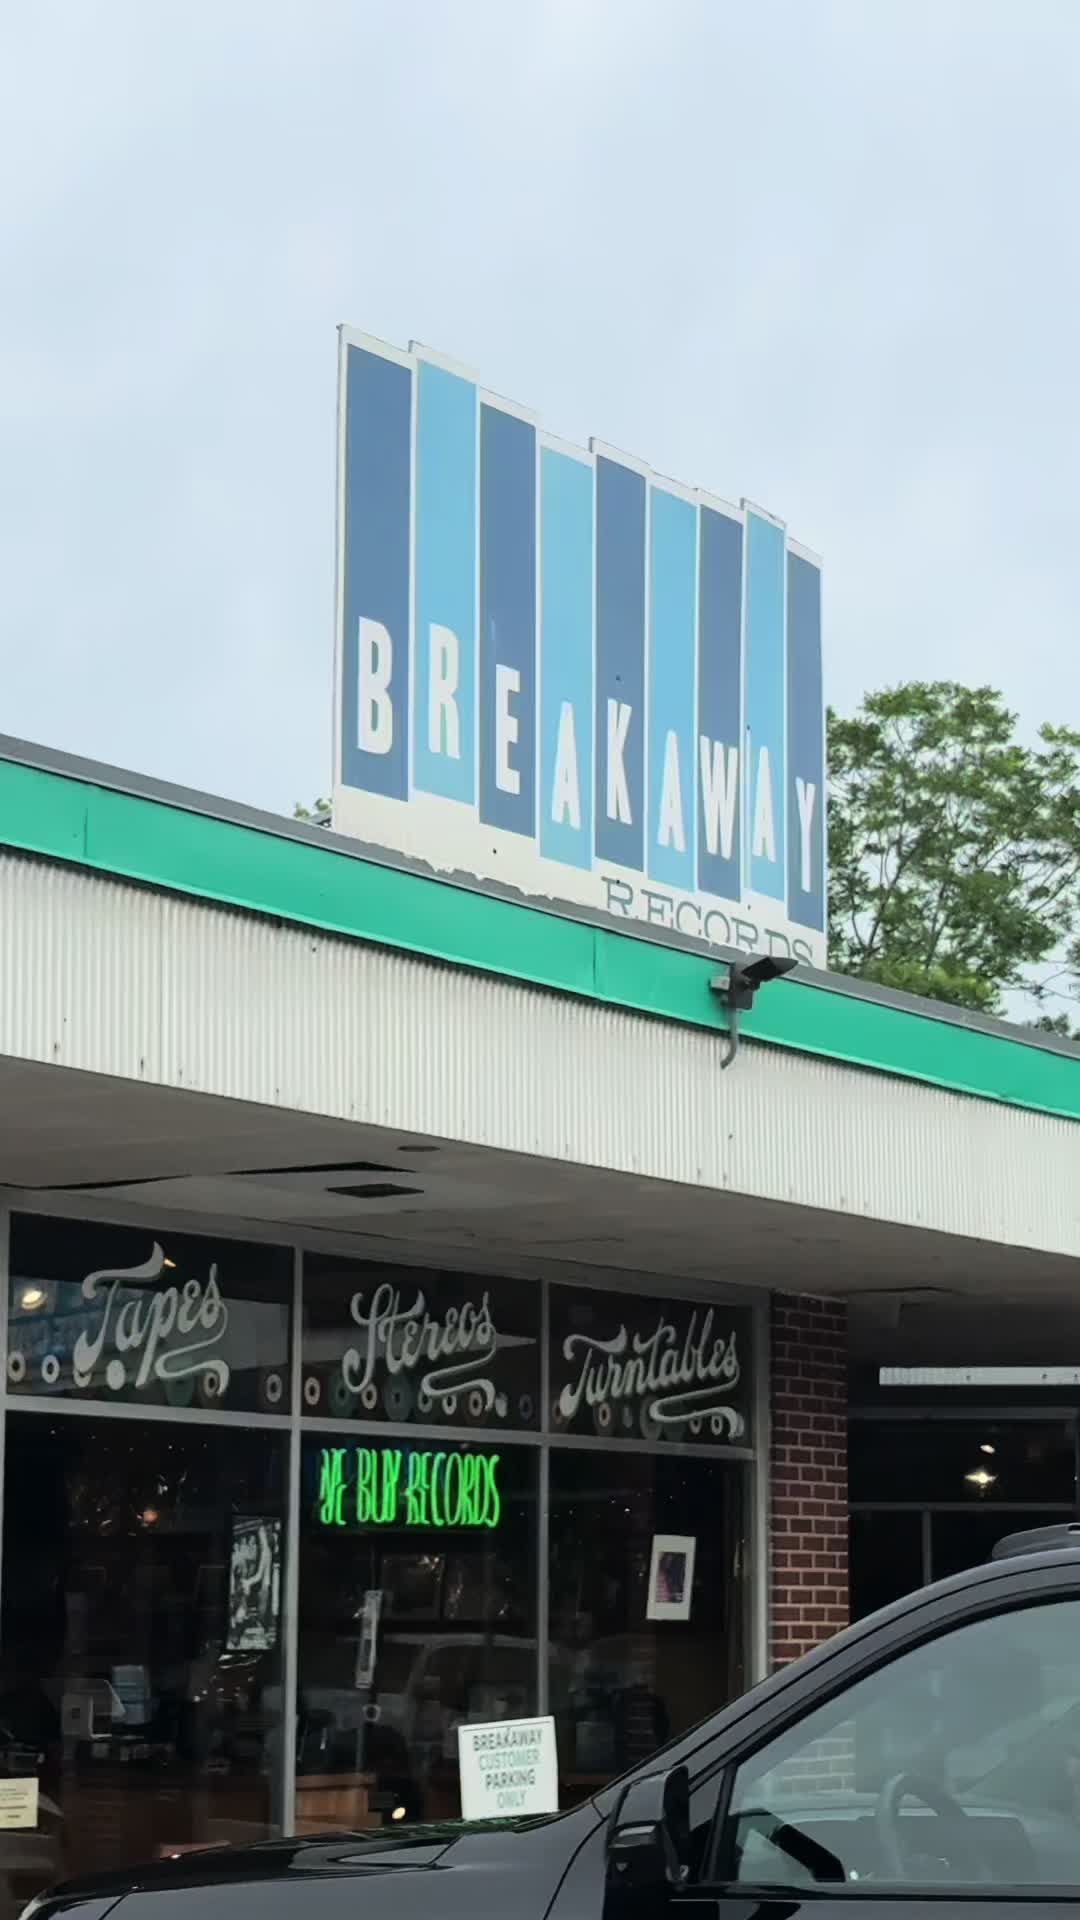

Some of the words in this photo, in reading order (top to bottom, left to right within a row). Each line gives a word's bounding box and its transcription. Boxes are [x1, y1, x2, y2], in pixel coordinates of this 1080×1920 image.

[357, 615, 816, 893] BREAKAWAY
[601, 876, 815, 968] RECORDS
[73, 1241, 230, 1397] Tapes
[342, 1283, 497, 1410] Stereos
[559, 1307, 744, 1440] Turntables
[319, 1448, 347, 1525] WE
[356, 1448, 402, 1523] BUY
[404, 1452, 500, 1528] RECORDS
[472, 1729, 542, 1752] BREAKAWAY
[479, 1749, 541, 1771] CUSTOMER
[485, 1768, 536, 1791] PARKING
